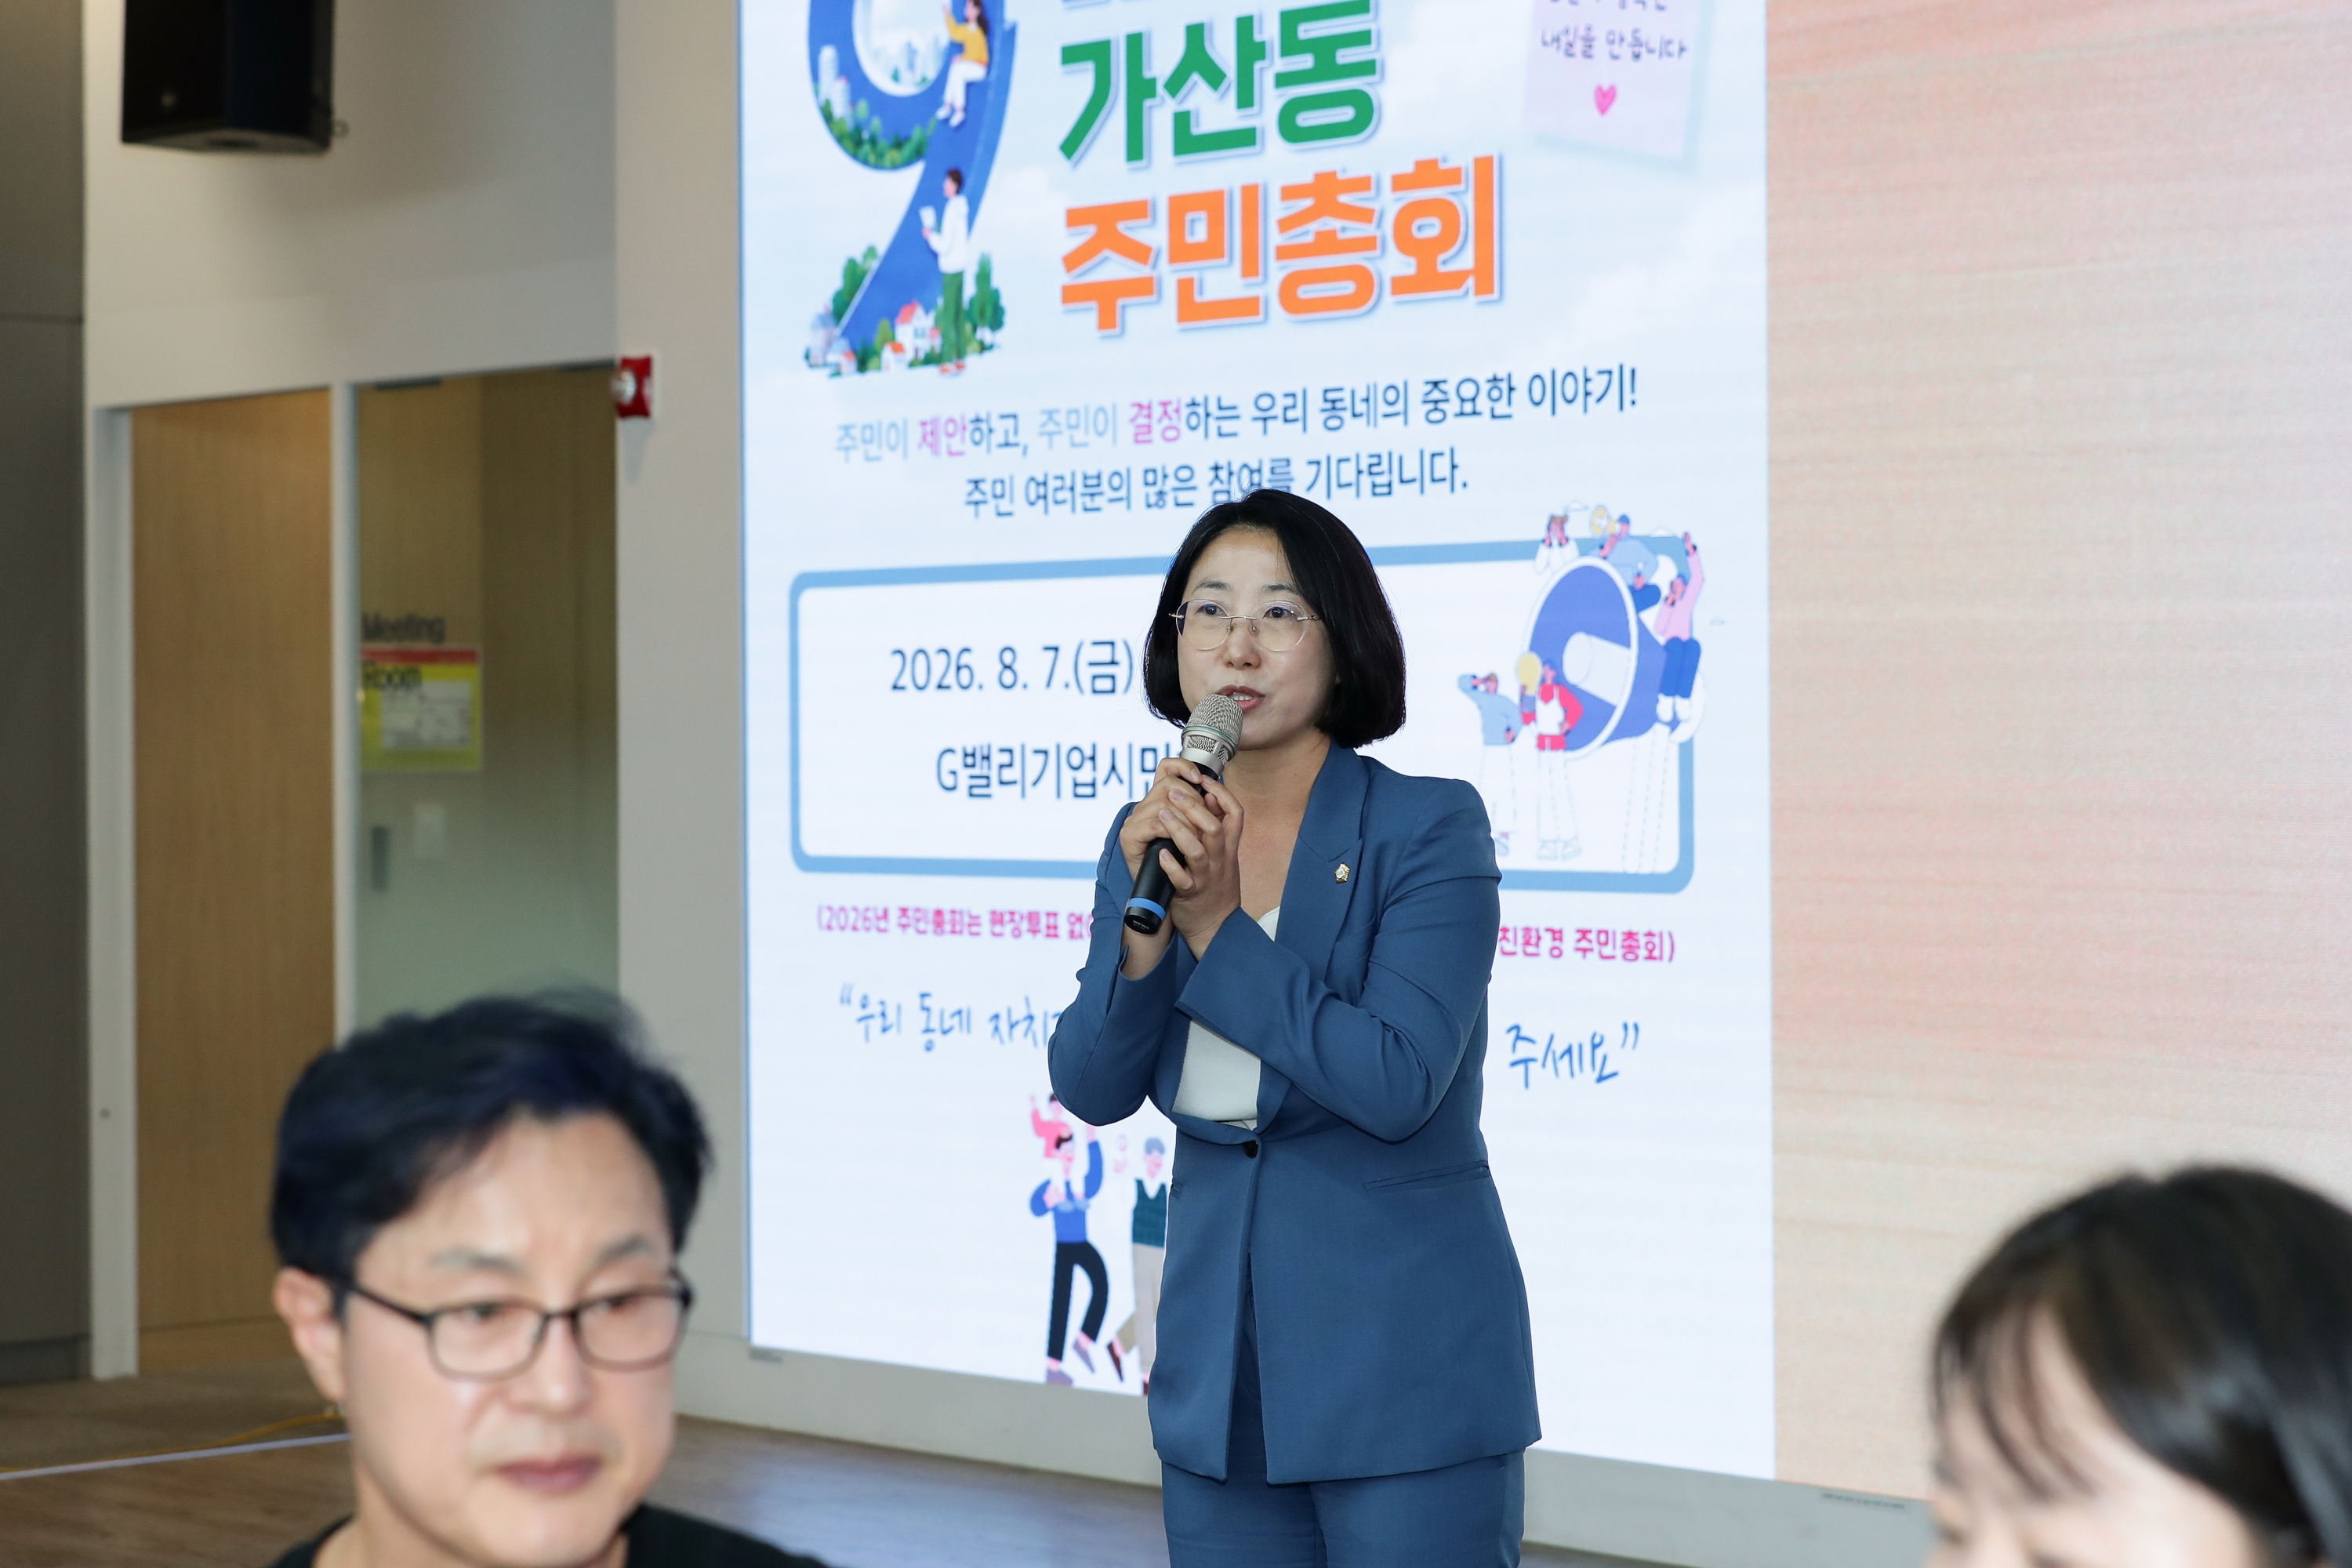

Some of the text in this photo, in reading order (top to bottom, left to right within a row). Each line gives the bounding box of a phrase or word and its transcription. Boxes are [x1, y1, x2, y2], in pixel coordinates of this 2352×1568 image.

[1541, 25, 1687, 62] 내일을 만듭니다
[1059, 0, 1378, 162] 가산동
[1060, 154, 1496, 332] 주민총회
[836, 364, 1635, 463] 주민이 제안하고, 주민이 결정하는 우리 동네의 중요한 이야기!
[965, 447, 1468, 517] 주민 여러분의 많은 참여를 기다립니다.
[891, 641, 1133, 695] 2026. 8. 7.(금)
[936, 742, 1180, 799] G밸리기업시민
[818, 906, 1674, 962] (2026년 주민총회는 현장투표 없 친환경 주민총회)
[919, 992, 971, 1052] 동네
[989, 996, 1061, 1048] 자치
